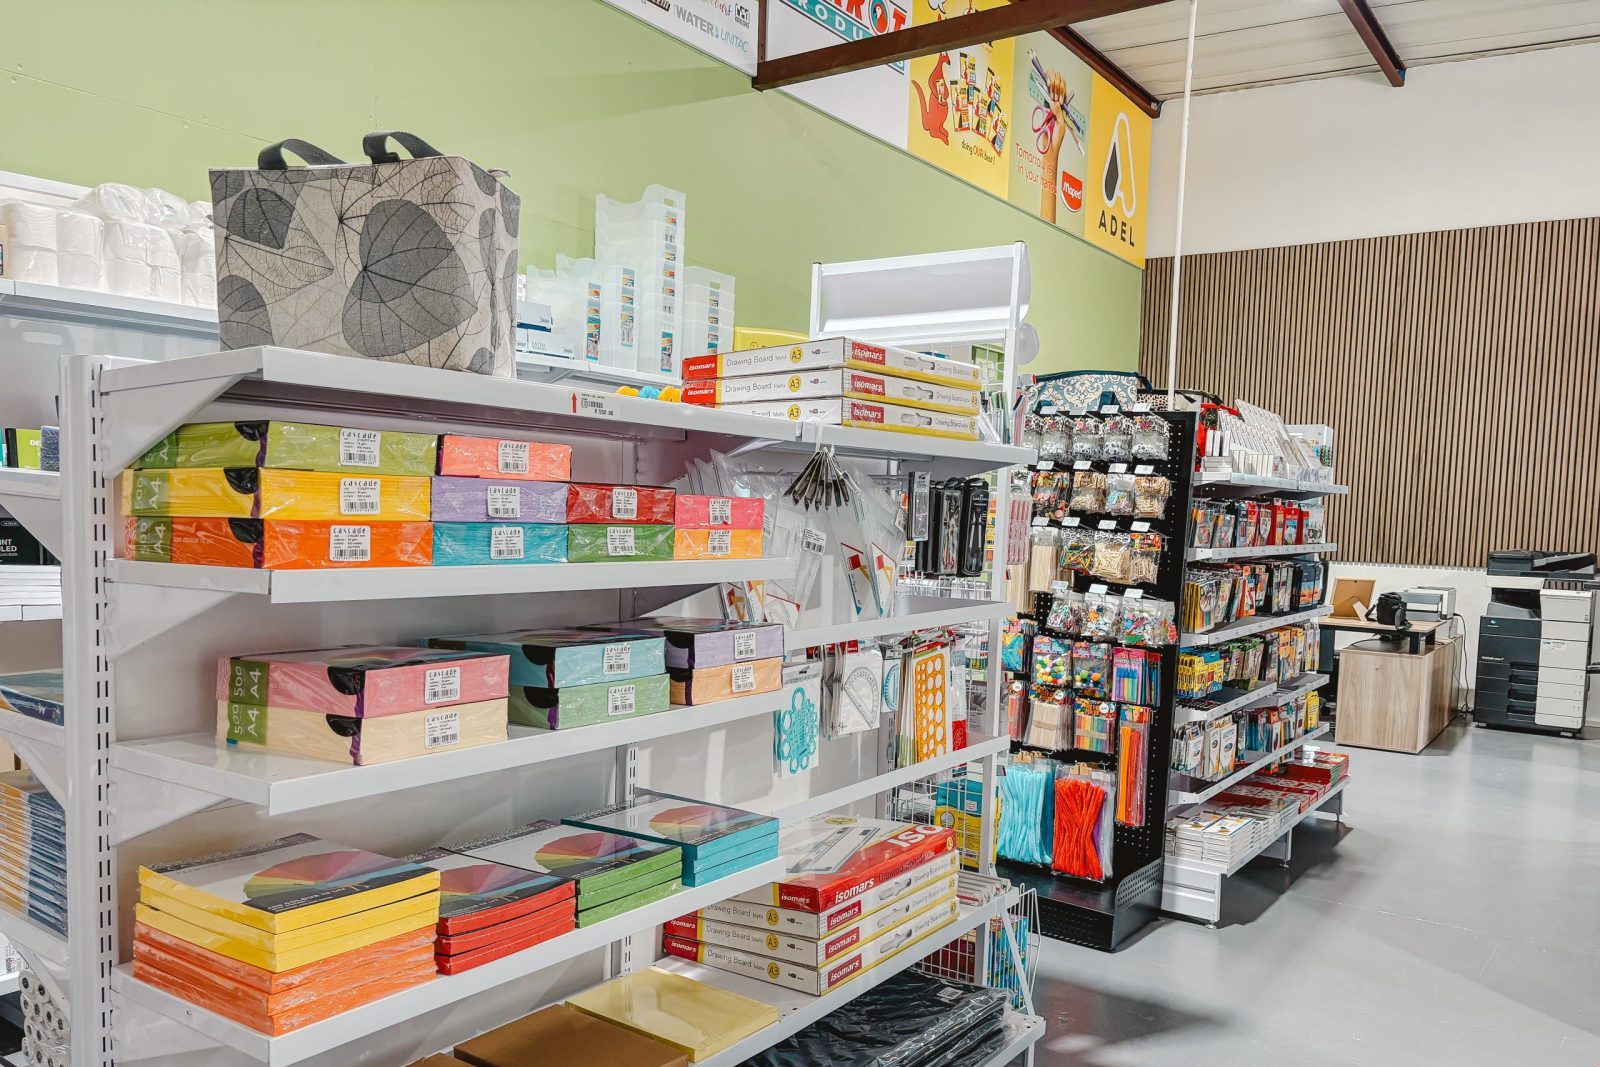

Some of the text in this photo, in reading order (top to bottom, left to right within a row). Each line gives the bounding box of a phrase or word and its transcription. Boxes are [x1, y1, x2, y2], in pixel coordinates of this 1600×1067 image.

[675, 4, 714, 37] WATER
[961, 138, 973, 156] doing
[973, 144, 984, 159] OUR
[1017, 162, 1024, 174] in
[1025, 168, 1039, 182] your
[1063, 181, 1082, 200] Maped
[1098, 209, 1135, 248] ADEL
[726, 356, 752, 367] Drawing
[753, 353, 774, 364] Board
[792, 350, 801, 360] A3
[854, 346, 883, 361] isomars
[689, 362, 716, 371] isomars
[725, 384, 750, 394] Drawing
[752, 382, 771, 391] Board
[790, 378, 800, 388] A3
[688, 388, 714, 396] isomars
[789, 407, 800, 417] A3
[853, 406, 882, 419] isomars
[342, 431, 377, 439] cascade
[135, 477, 144, 510] 500
[149, 477, 162, 510] A4
[153, 523, 166, 554] A4
[234, 666, 243, 697] 500
[249, 668, 261, 698] A4
[232, 704, 243, 735] 500
[248, 707, 260, 737] A4
[781, 893, 811, 904] isomars
[835, 877, 875, 904] isomars
[767, 912, 777, 923] A3
[830, 905, 859, 926] isomars
[670, 920, 695, 929] isomars
[707, 925, 731, 937] Drawing
[732, 930, 751, 940] Board
[671, 941, 697, 952] isomars
[767, 936, 777, 947] A3
[828, 932, 857, 954] isomars
[707, 949, 732, 963] Drawing
[734, 957, 752, 968] Board
[768, 965, 779, 975] A3
[830, 959, 860, 982] isomars
